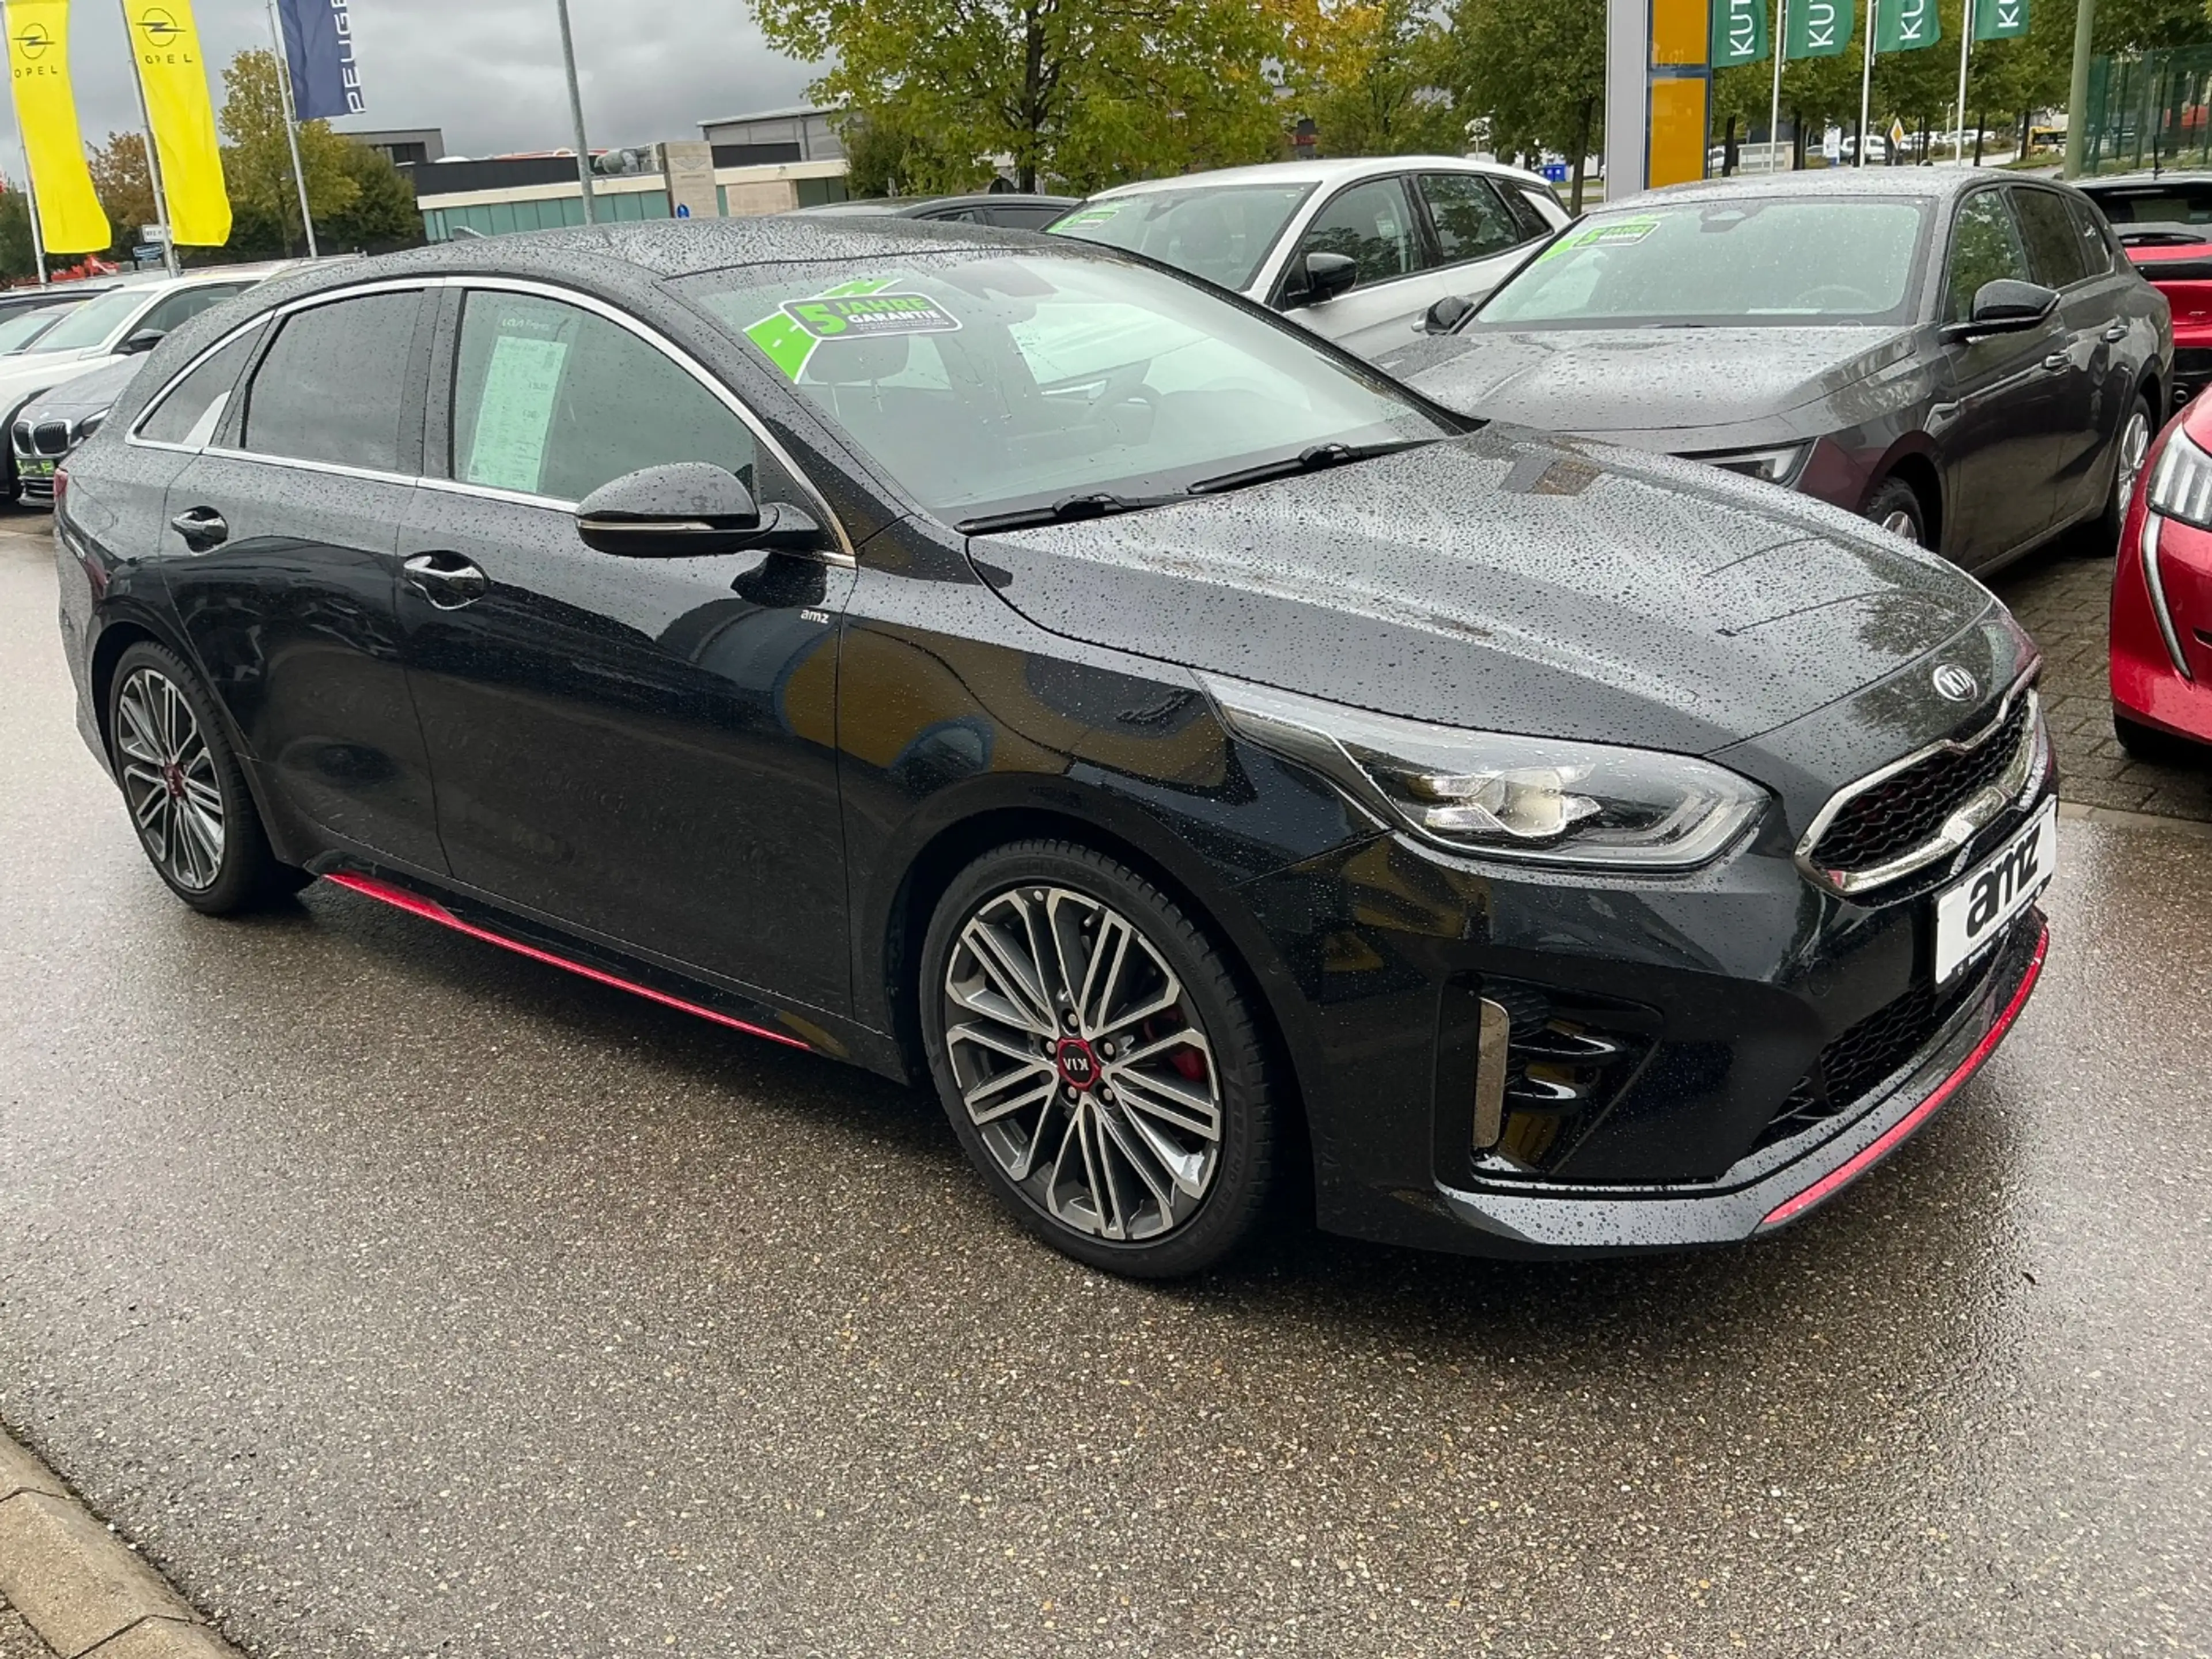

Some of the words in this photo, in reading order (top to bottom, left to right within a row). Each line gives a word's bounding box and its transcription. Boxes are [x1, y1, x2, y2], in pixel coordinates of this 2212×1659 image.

[1998, 0, 2020, 28] K
[1808, 0, 1835, 48] KU
[145, 54, 193, 65] OPEL
[14, 65, 58, 78] OPEL
[794, 302, 847, 334] 5
[836, 298, 930, 315] JAHRE
[847, 310, 941, 324] GARANTIE
[801, 609, 830, 624] amz
[1966, 822, 2041, 940] amz
[1062, 1058, 1090, 1071] KIA
